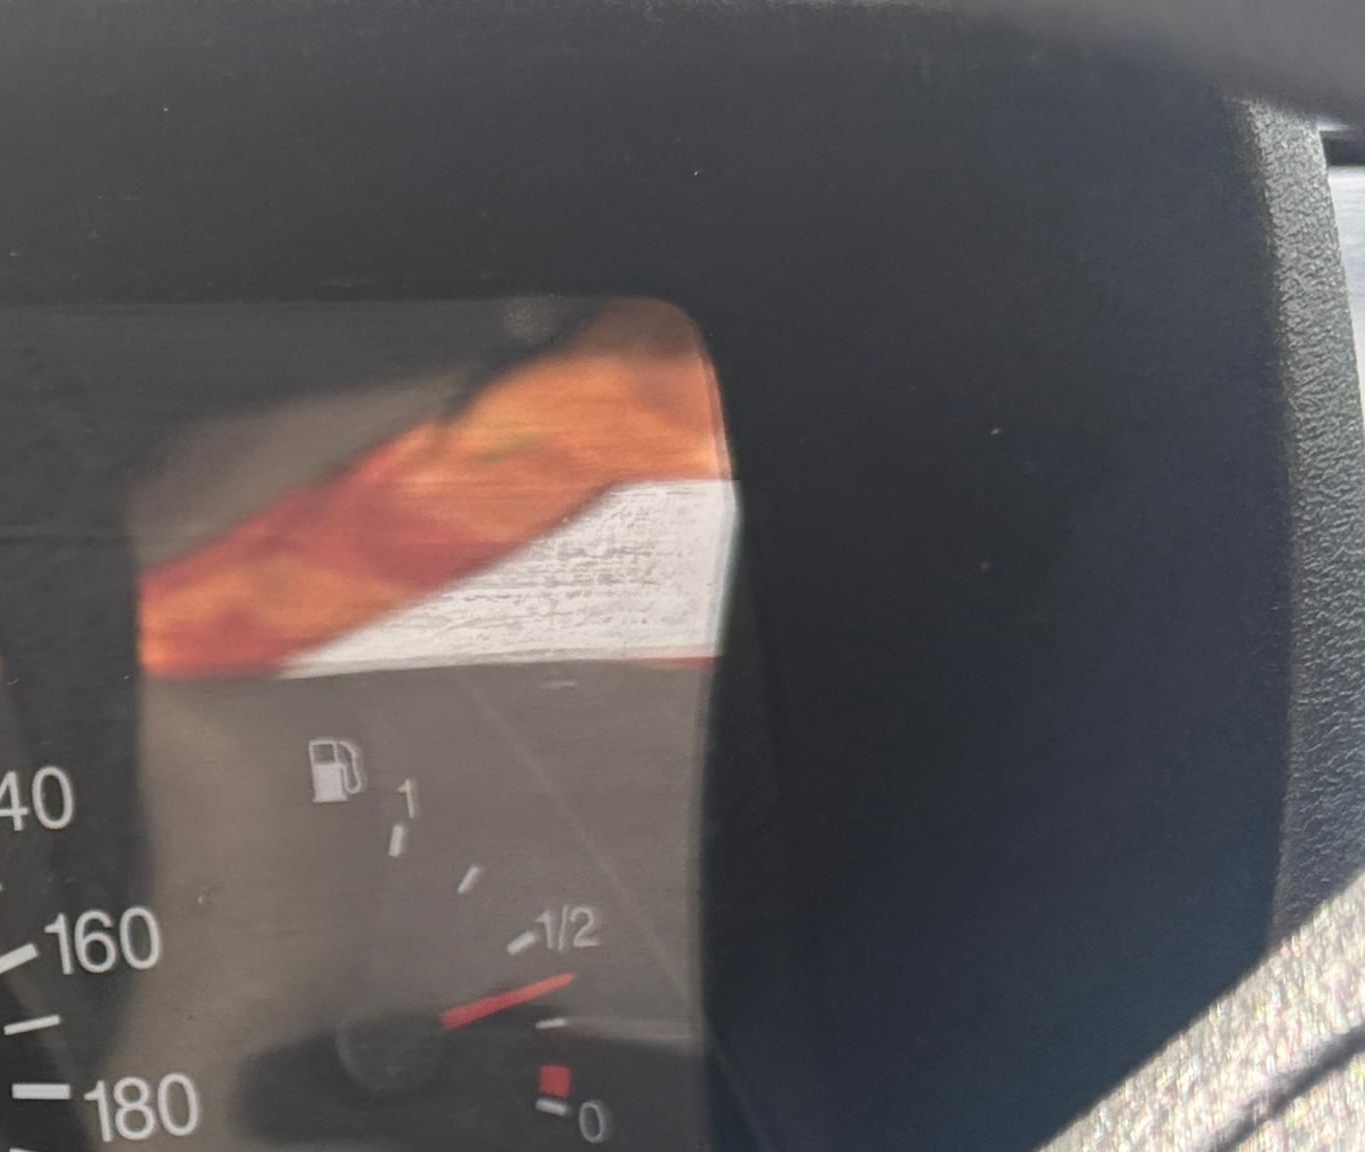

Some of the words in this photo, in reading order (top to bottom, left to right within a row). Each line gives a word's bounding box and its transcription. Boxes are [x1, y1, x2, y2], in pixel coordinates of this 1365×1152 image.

[398, 779, 419, 817] 1
[43, 906, 162, 976] 160
[540, 905, 600, 954] 1/2
[83, 1072, 200, 1143] 180
[578, 1098, 612, 1144] 0
